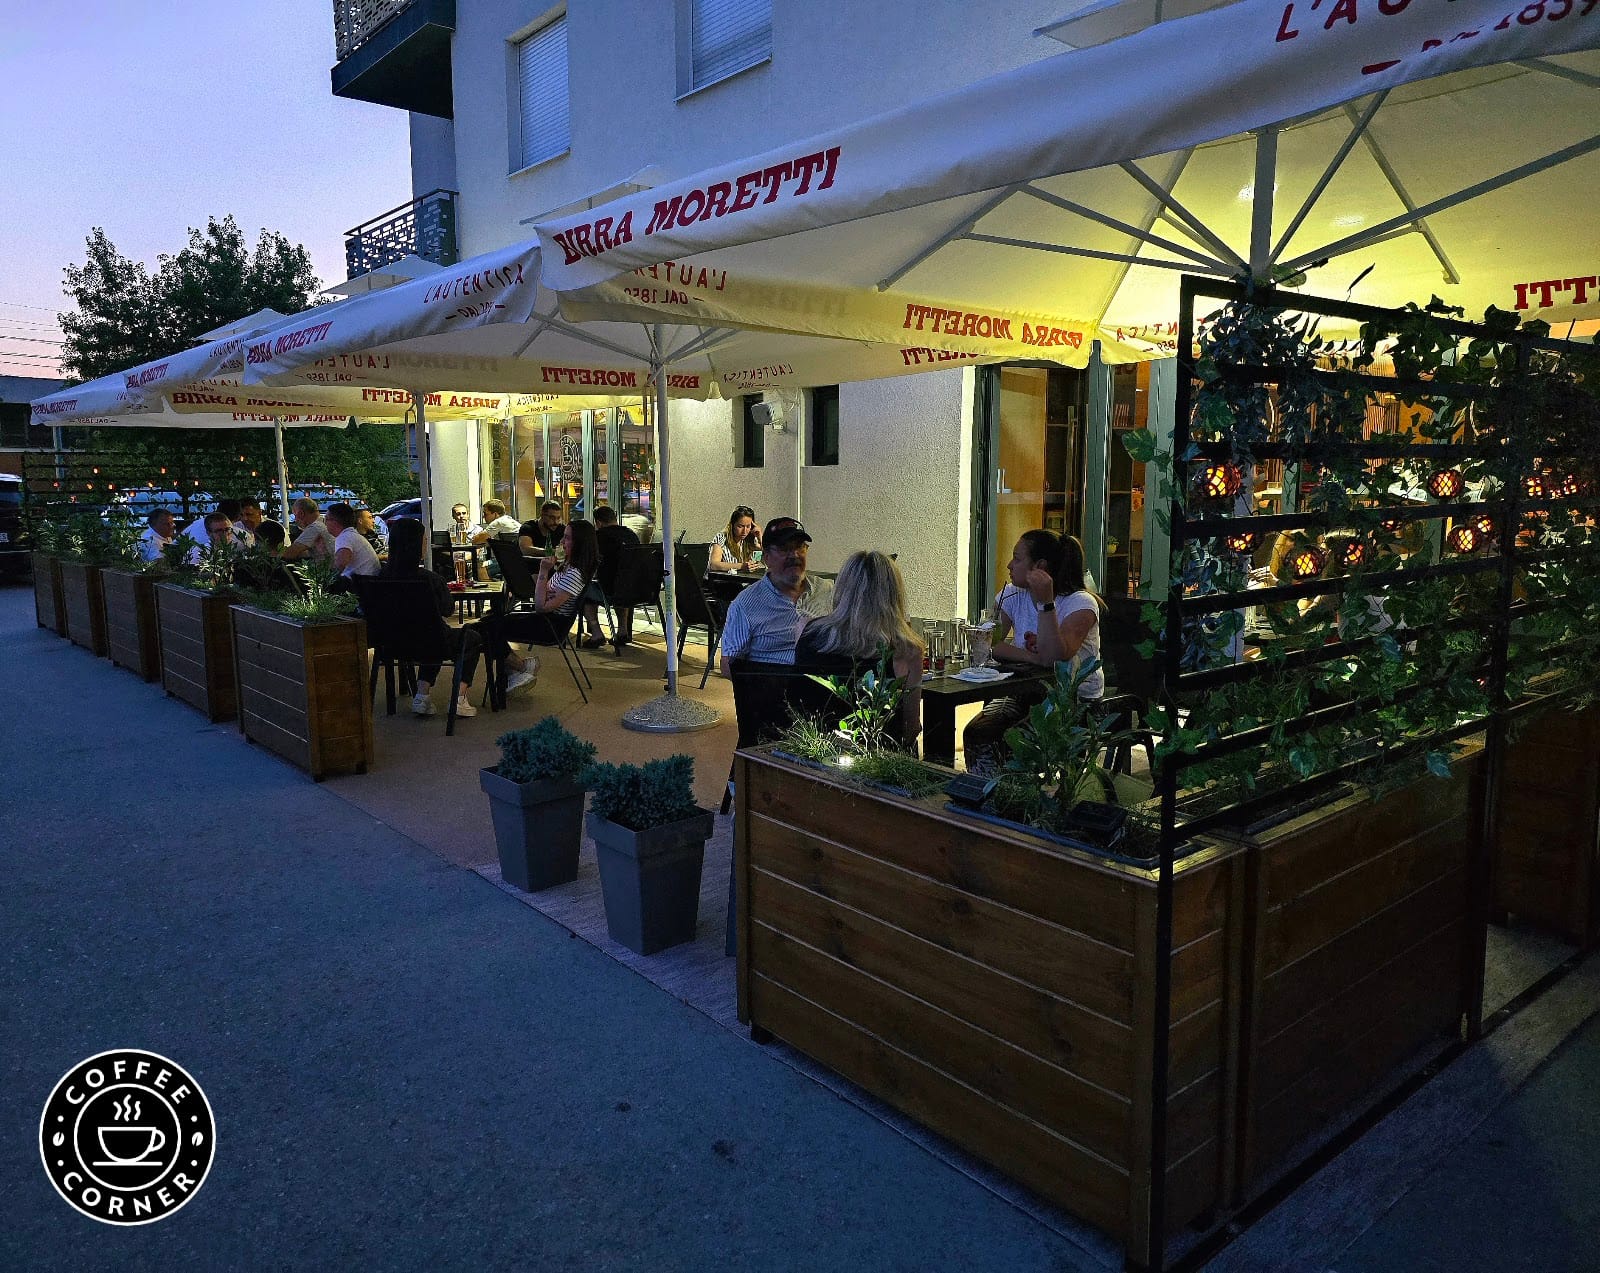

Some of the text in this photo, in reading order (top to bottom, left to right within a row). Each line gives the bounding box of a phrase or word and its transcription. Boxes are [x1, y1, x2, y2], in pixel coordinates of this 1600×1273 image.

[645, 146, 842, 235] MORETTI
[423, 263, 524, 304] L'AUTENTICA
[275, 321, 334, 355] MORETTI
